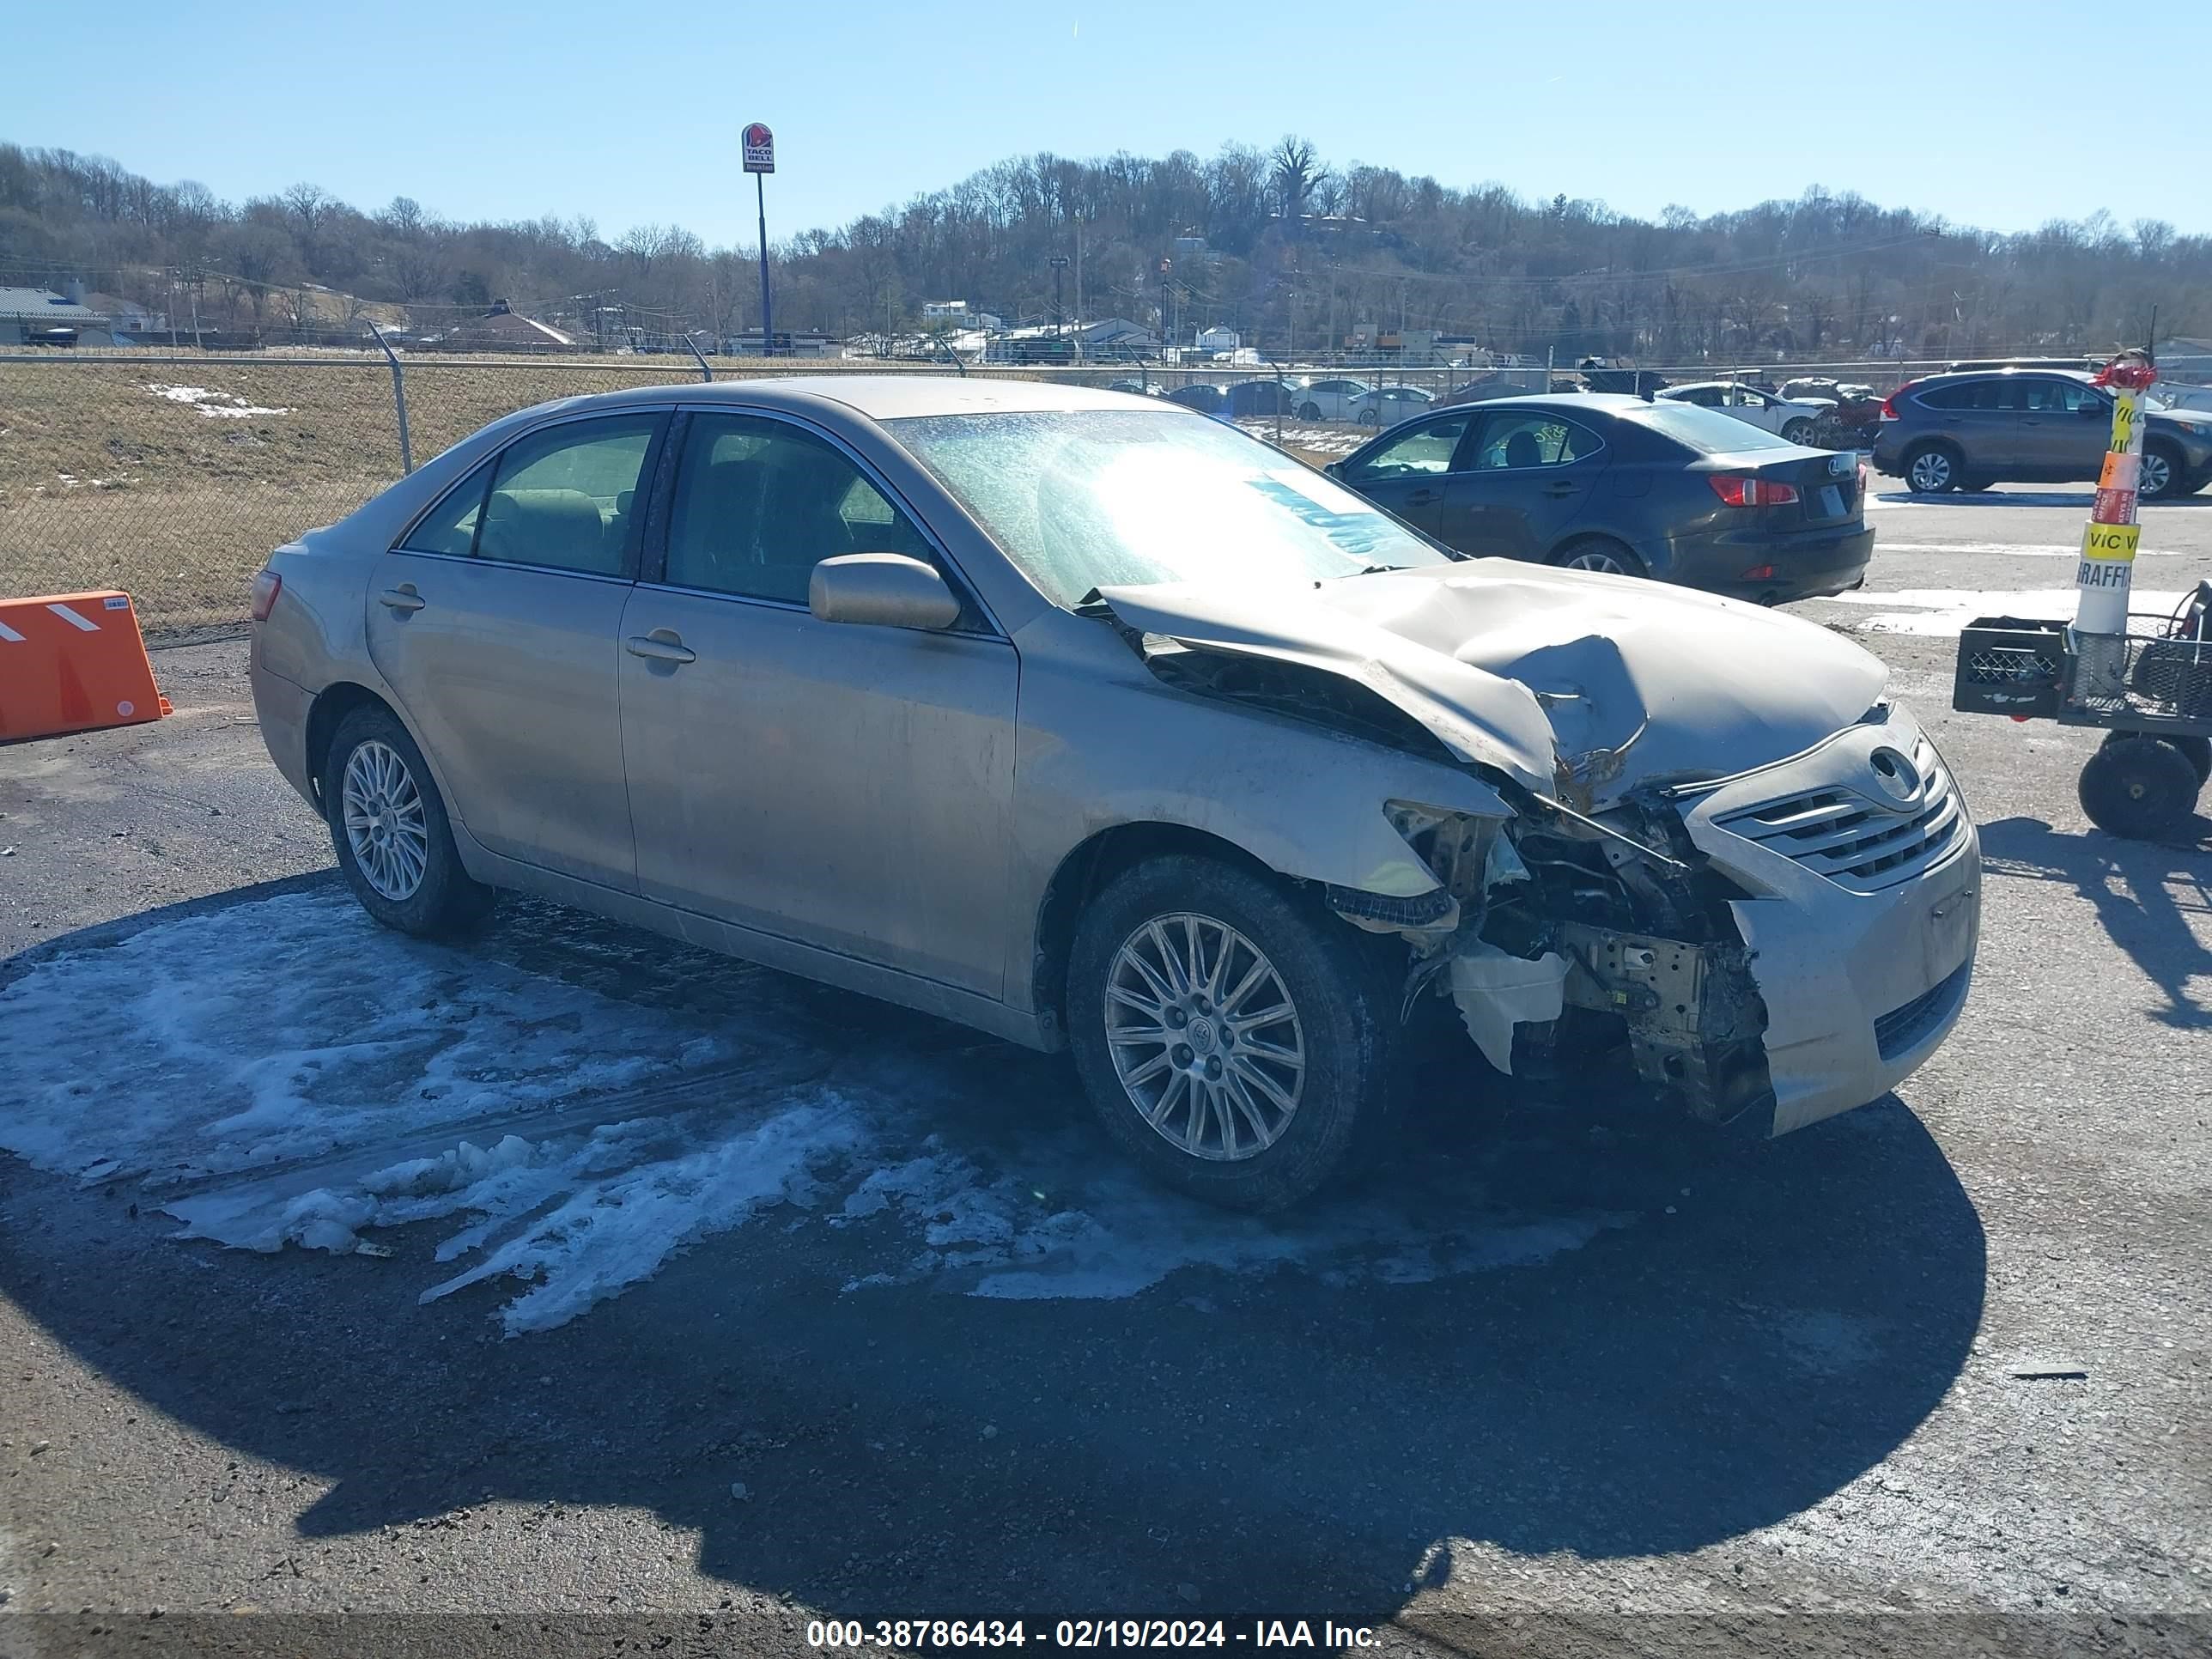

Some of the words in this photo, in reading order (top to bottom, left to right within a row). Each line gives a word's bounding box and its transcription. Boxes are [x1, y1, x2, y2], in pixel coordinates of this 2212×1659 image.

[2096, 492, 2109, 520] OFFICE
[2118, 502, 2127, 524] KEYS
[2090, 532, 2122, 550] VIC
